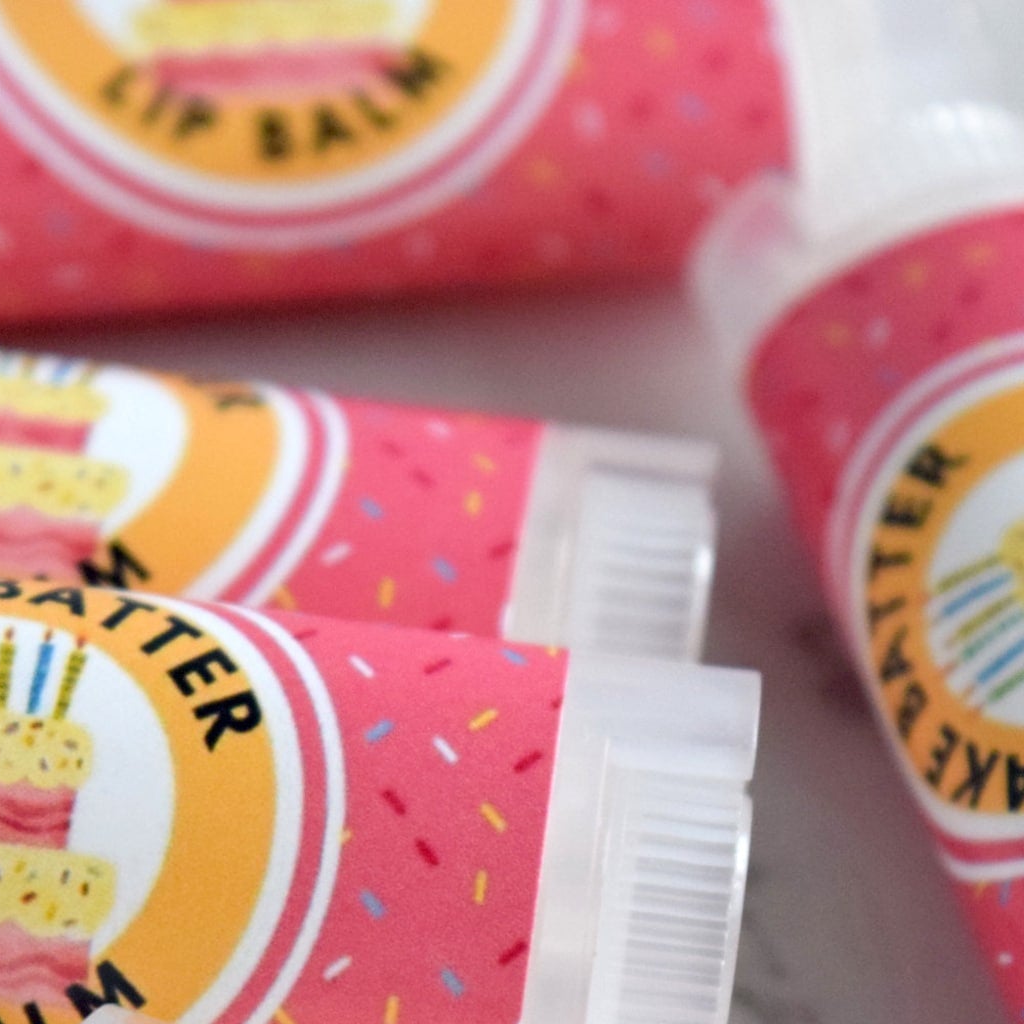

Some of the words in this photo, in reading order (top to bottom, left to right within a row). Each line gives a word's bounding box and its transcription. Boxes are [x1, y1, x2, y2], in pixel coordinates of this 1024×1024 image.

[101, 66, 218, 141] LIP
[258, 45, 454, 161] BALM
[868, 442, 969, 740] BATTER
